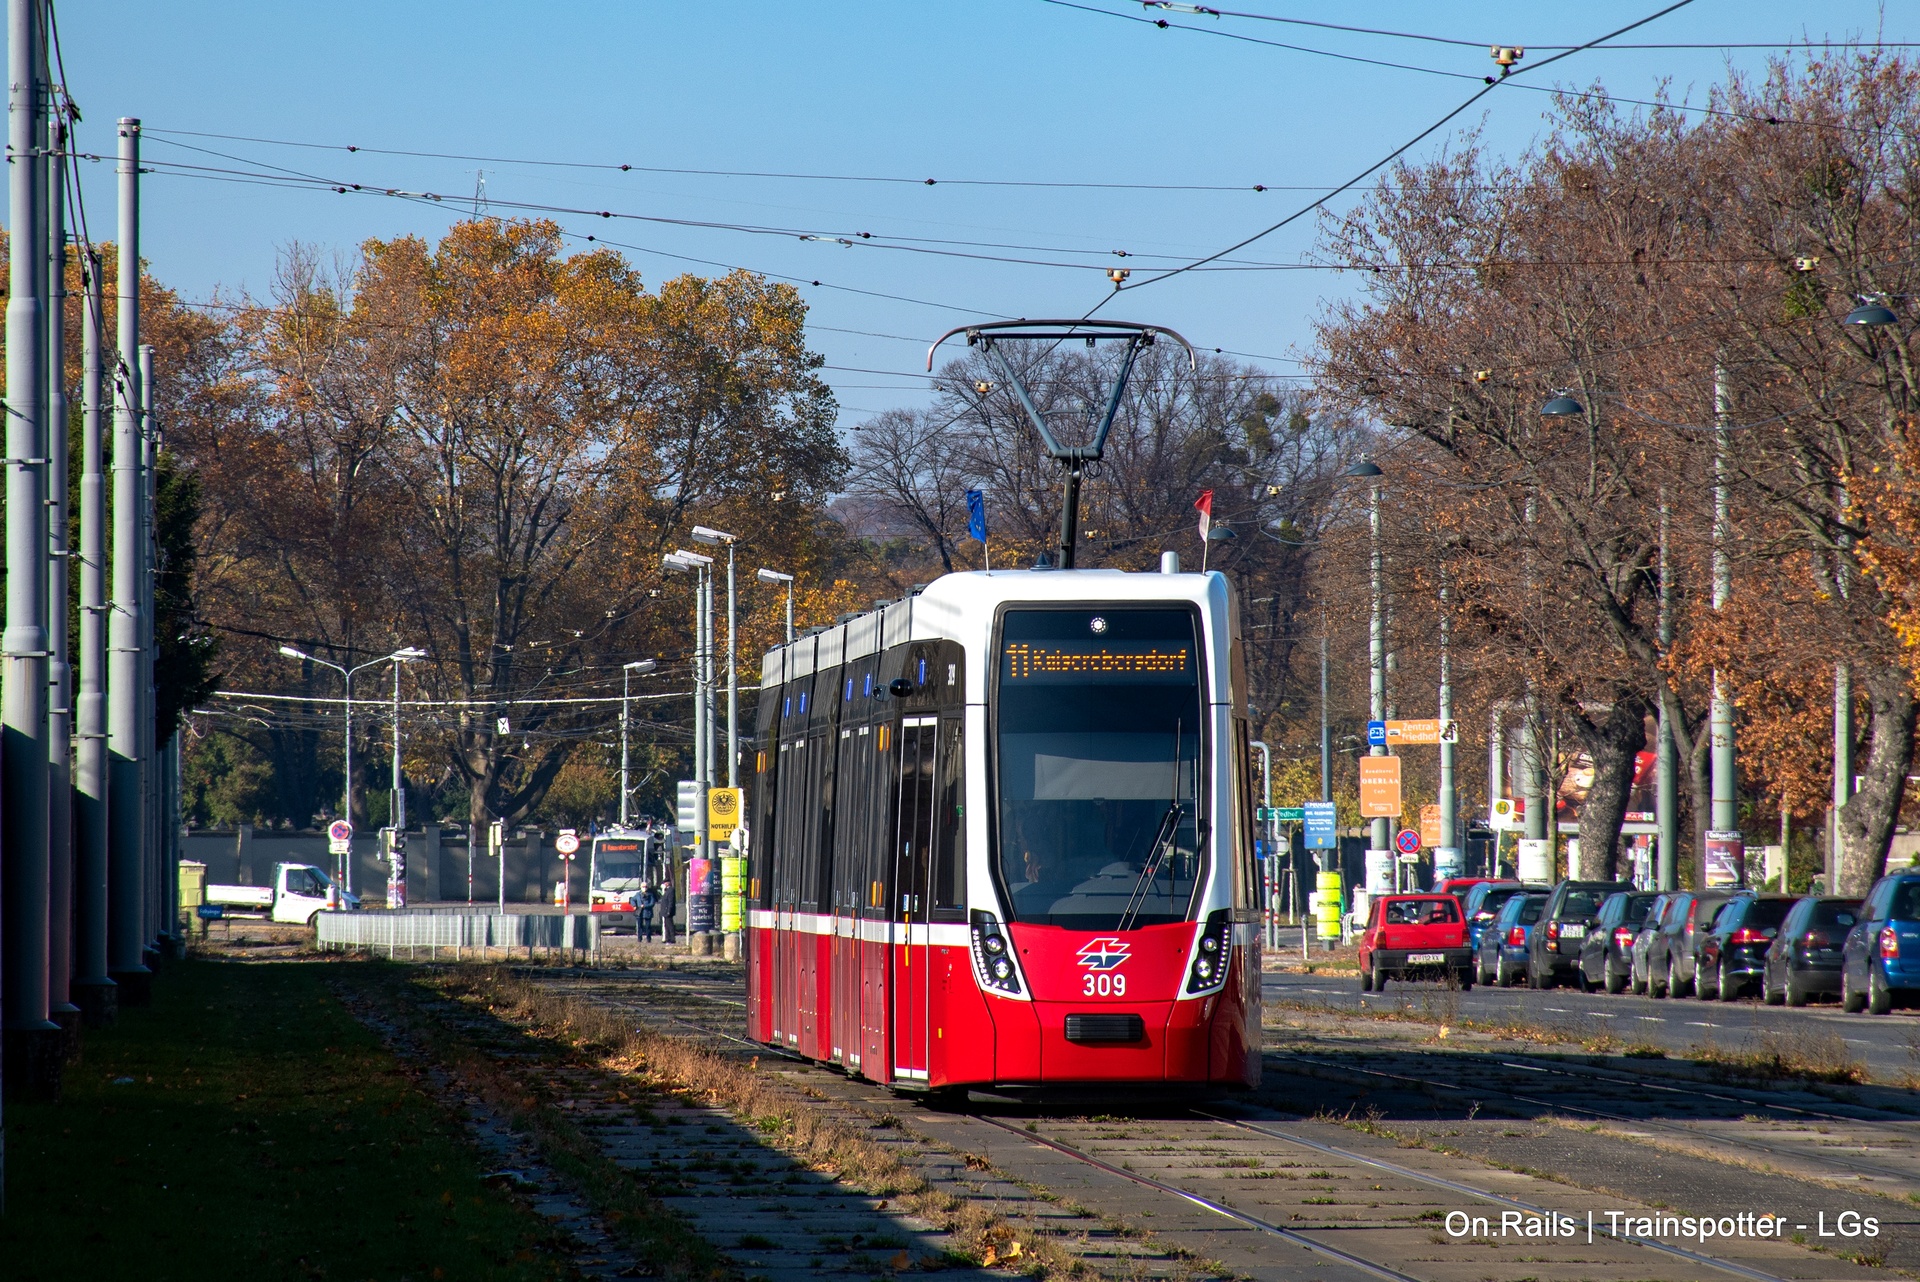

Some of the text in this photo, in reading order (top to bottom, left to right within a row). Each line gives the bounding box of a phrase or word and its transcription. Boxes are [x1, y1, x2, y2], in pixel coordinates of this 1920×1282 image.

[1006, 644, 1187, 677] 11 Kaiserebersdorf
[1402, 722, 1438, 731] Zentral-
[1401, 732, 1437, 741] friedhof
[1083, 973, 1126, 997] 309
